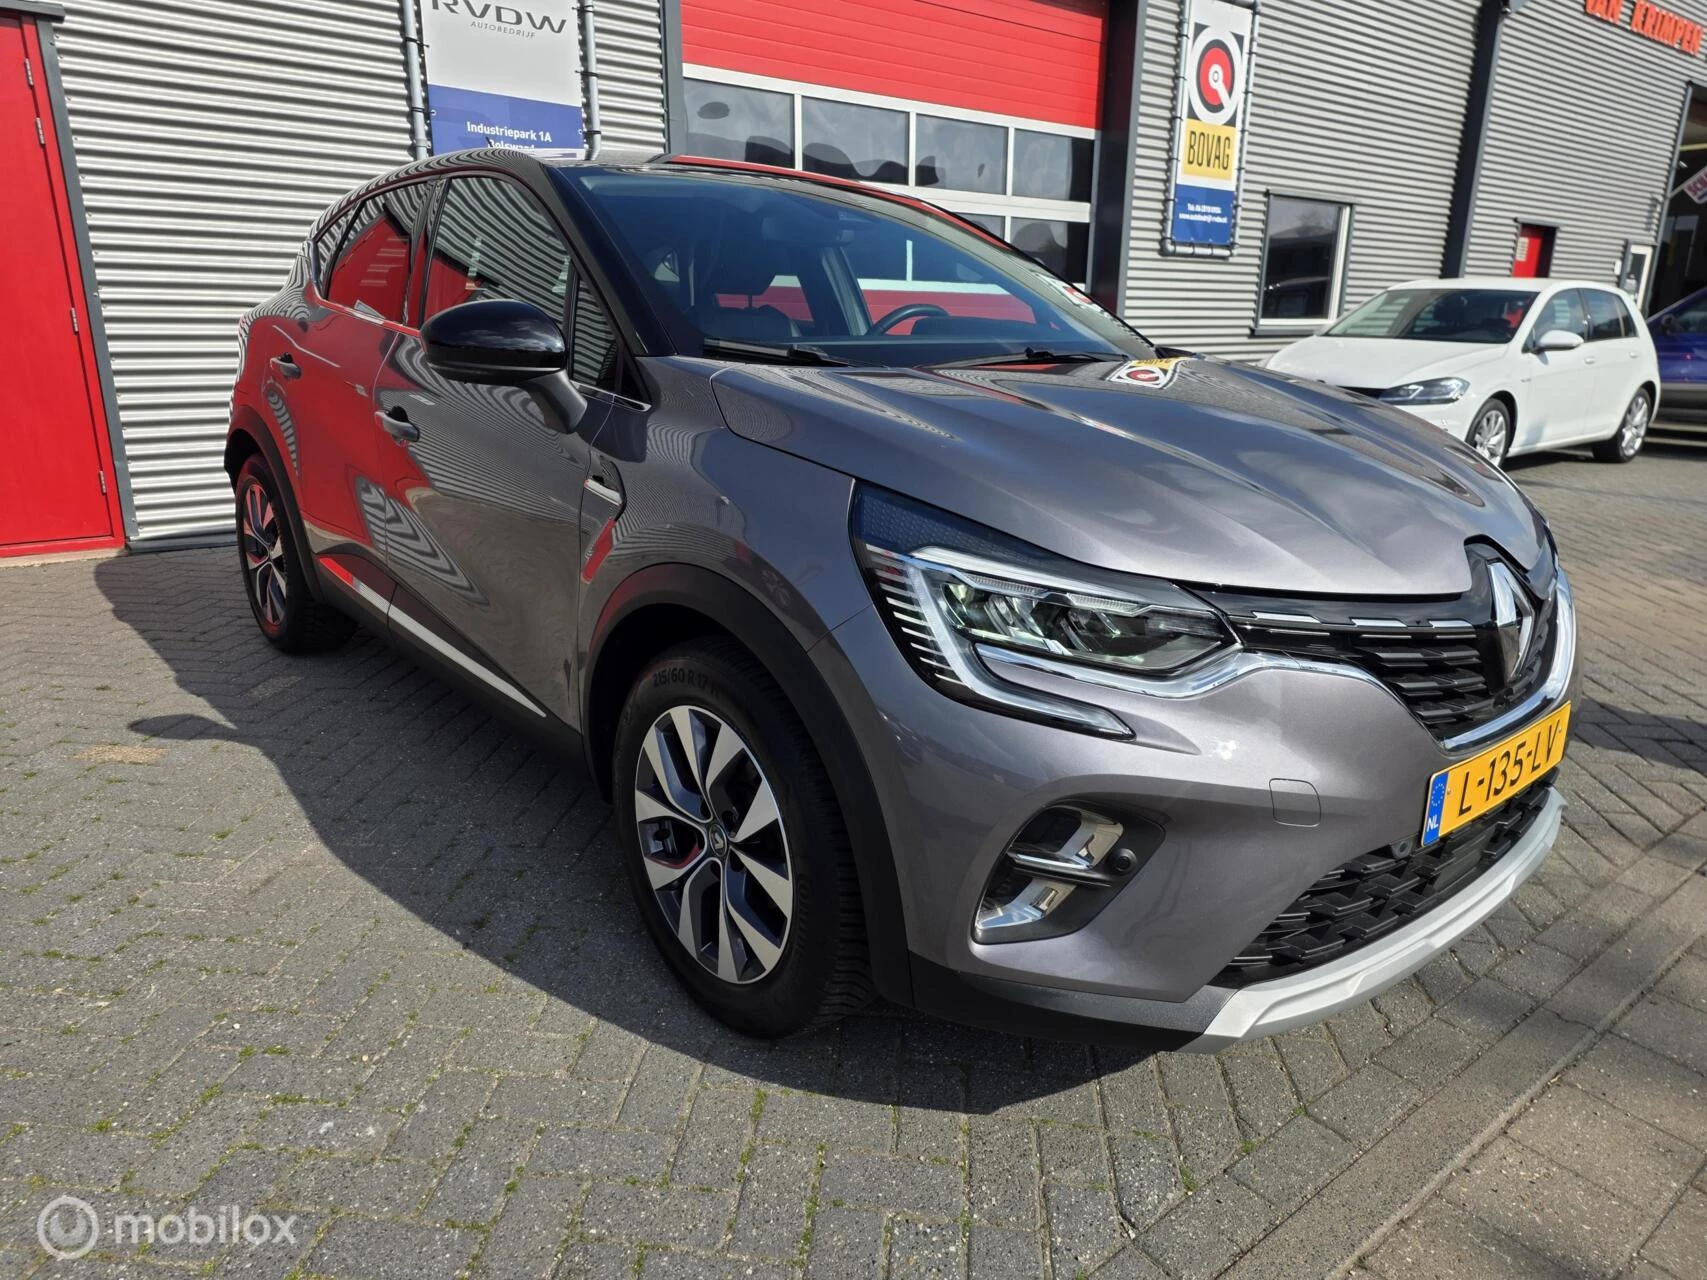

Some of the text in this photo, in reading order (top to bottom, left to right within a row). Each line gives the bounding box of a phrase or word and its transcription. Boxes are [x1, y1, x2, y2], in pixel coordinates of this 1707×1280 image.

[432, 0, 567, 34] RVDW
[470, 21, 536, 39] AUTOBEDRIJF
[466, 121, 553, 143] Industriepark 1A
[1187, 130, 1231, 171] BOVAG
[1458, 719, 1560, 817] L-135-LV
[1426, 815, 1439, 833] NL
